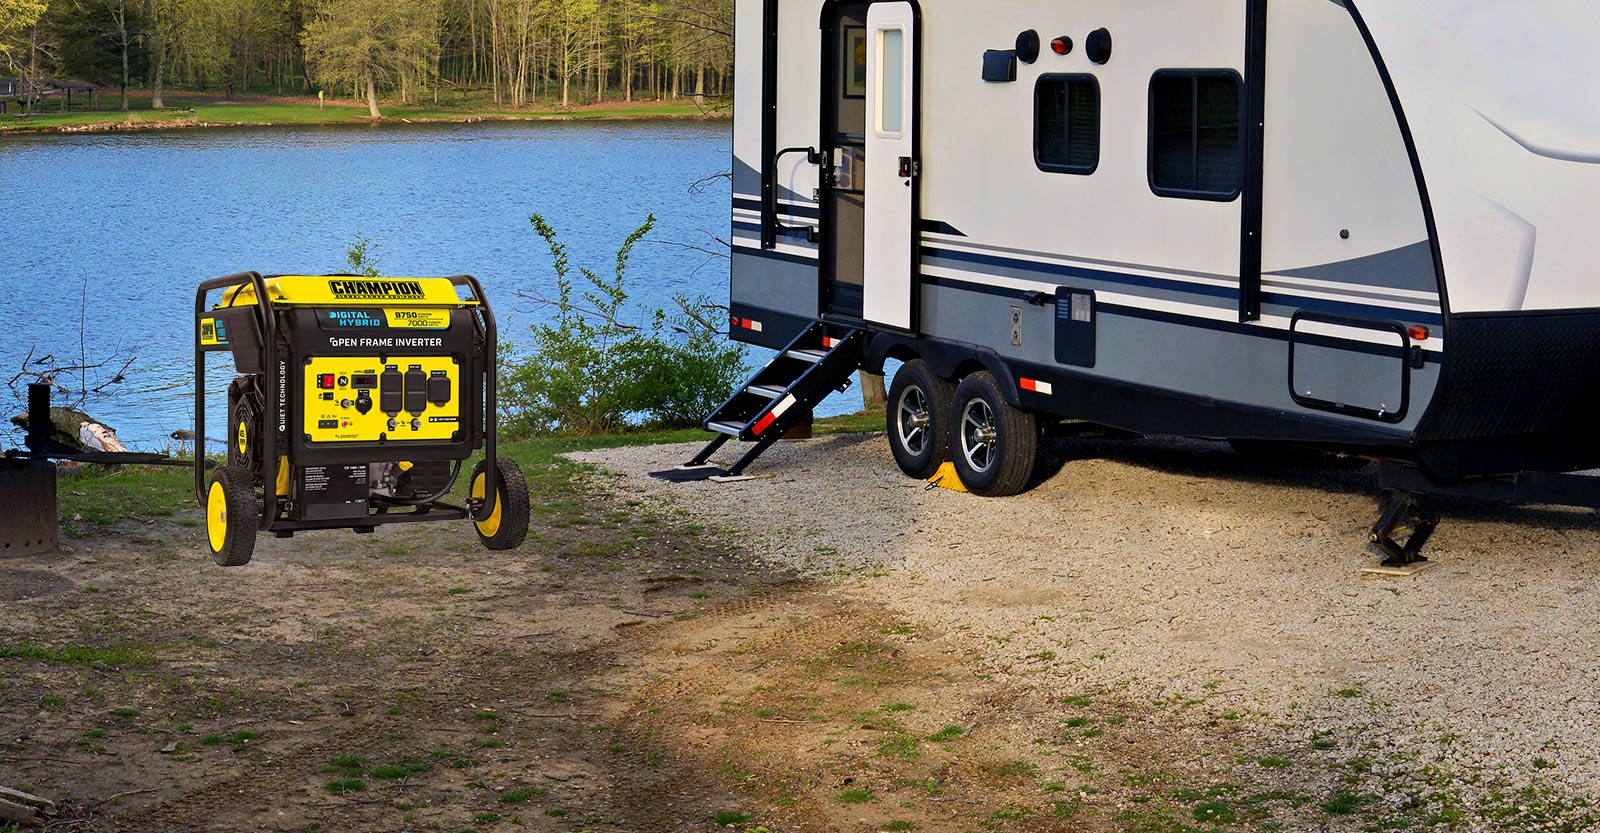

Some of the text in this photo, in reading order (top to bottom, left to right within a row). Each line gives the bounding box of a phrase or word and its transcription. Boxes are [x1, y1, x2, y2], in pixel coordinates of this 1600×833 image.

[328, 280, 425, 296] CHAMPION
[329, 311, 370, 319] DIGITAL
[339, 319, 381, 327] HYBRID
[329, 337, 442, 347] OPEN FRAME INVERTER
[278, 408, 286, 432] QUIET
